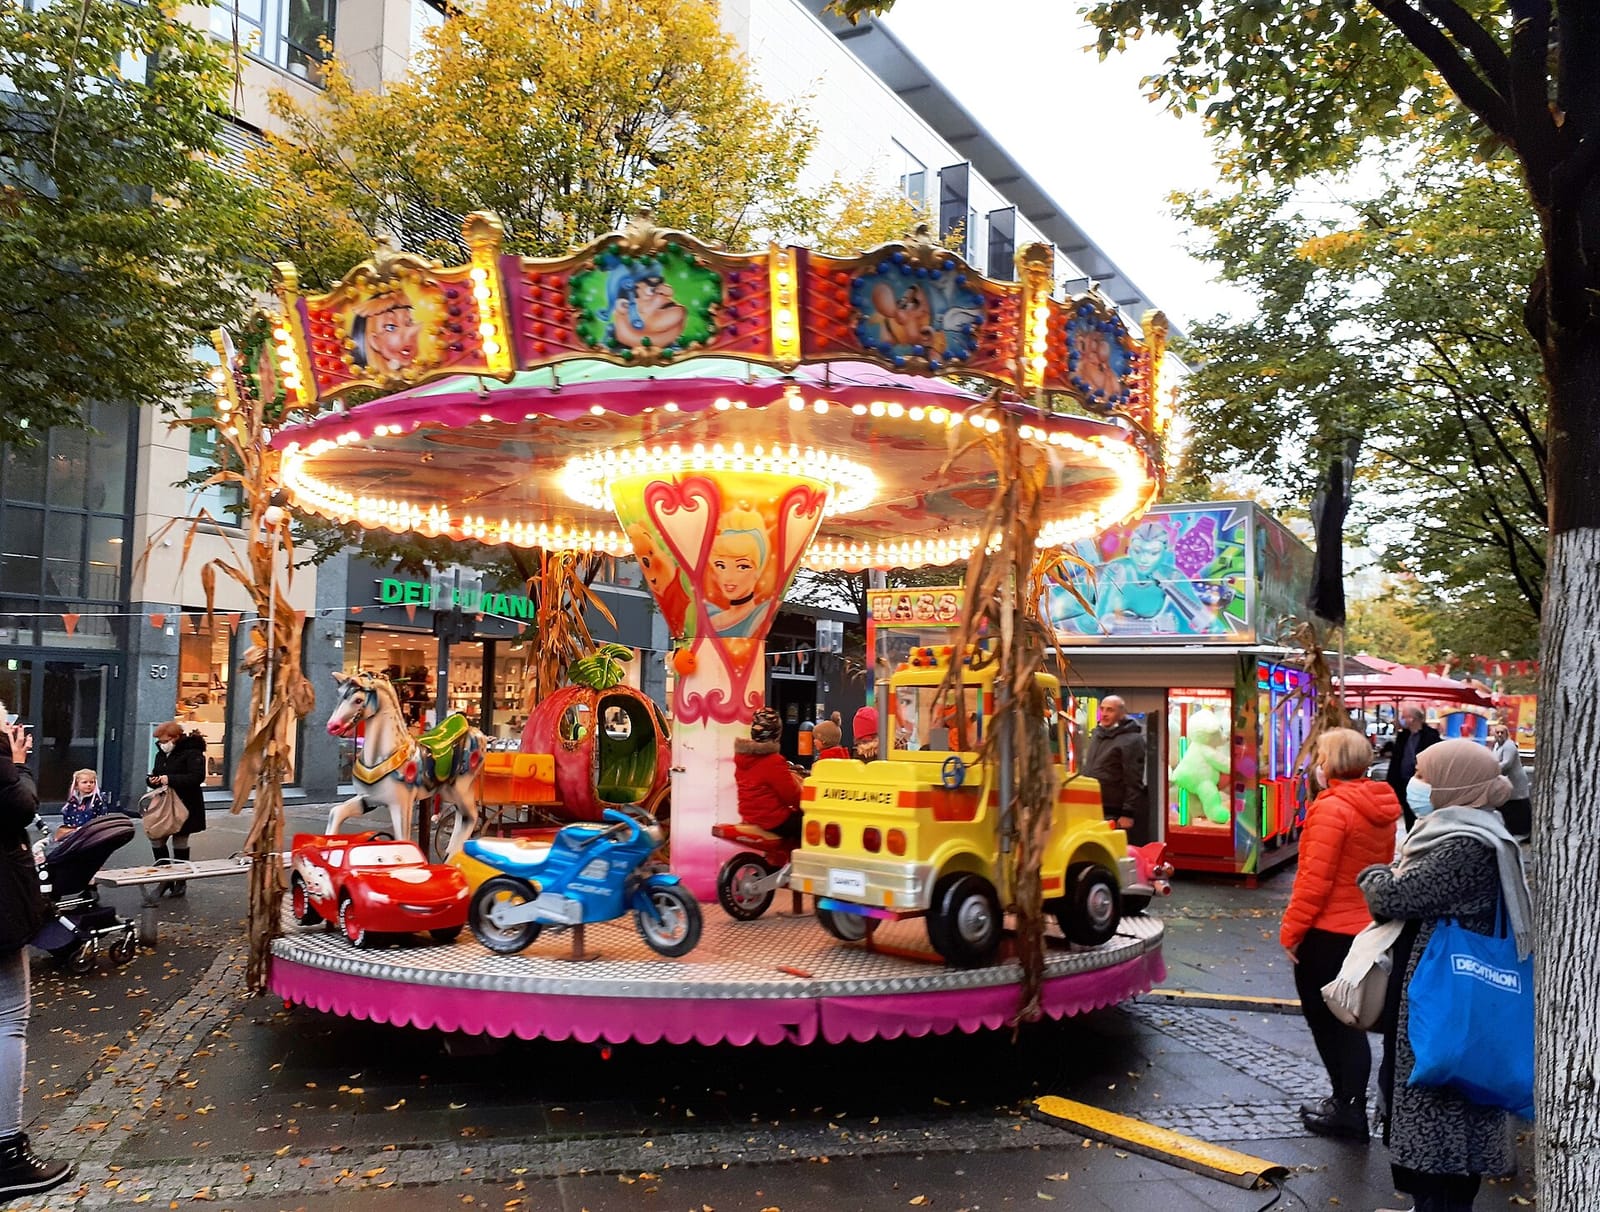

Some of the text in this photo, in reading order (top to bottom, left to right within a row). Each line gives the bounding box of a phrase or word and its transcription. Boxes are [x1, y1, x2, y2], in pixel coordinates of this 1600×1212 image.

[149, 664, 169, 679] 50
[823, 787, 894, 805] AMBULANCE
[1455, 958, 1518, 988] DECATHLON
